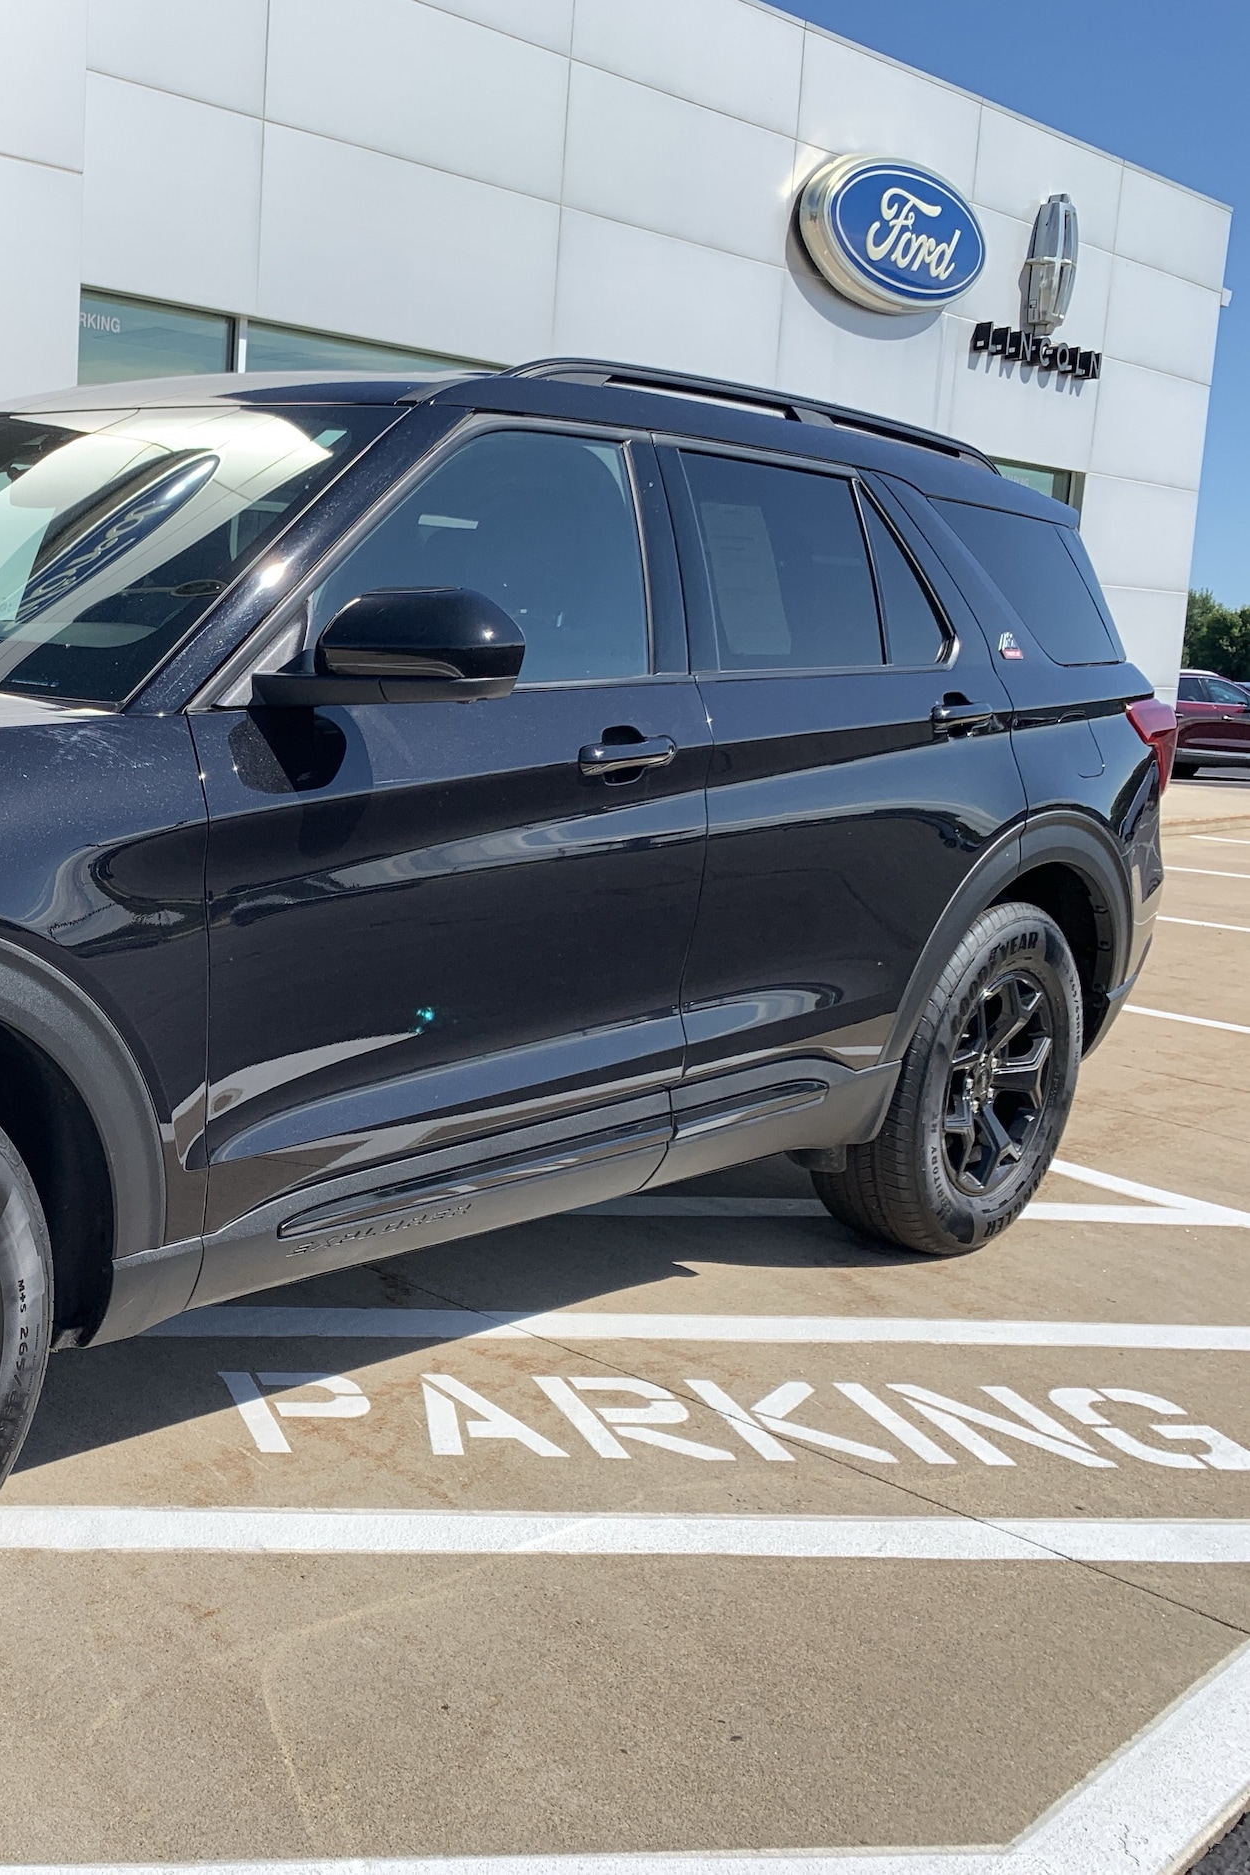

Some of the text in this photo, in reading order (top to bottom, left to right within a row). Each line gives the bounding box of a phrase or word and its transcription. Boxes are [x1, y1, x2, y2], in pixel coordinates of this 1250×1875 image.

[866, 187, 962, 281] Ford
[971, 321, 1102, 379] LINCOLN
[217, 1371, 1250, 1471] PARKING
